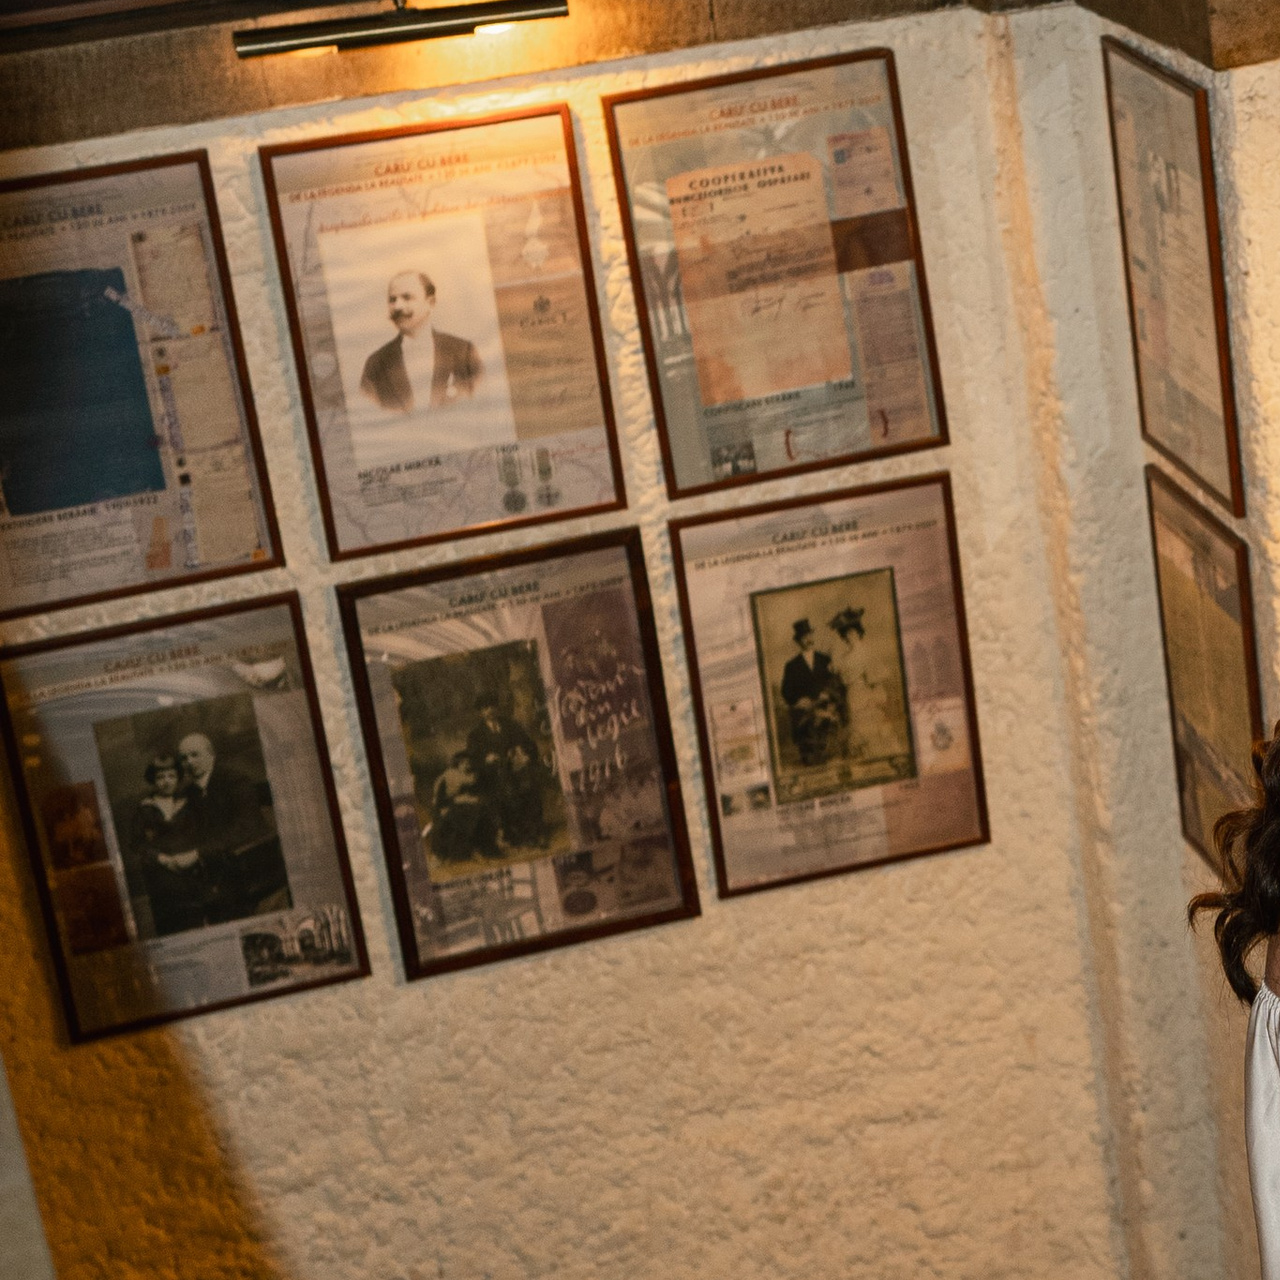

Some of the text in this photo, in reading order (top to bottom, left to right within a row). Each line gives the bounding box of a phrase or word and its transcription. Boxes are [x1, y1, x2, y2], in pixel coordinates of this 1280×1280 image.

[810, 525, 829, 538] CU
[831, 519, 859, 534] BERE
[488, 586, 507, 600] CU
[510, 579, 540, 595] BERE
